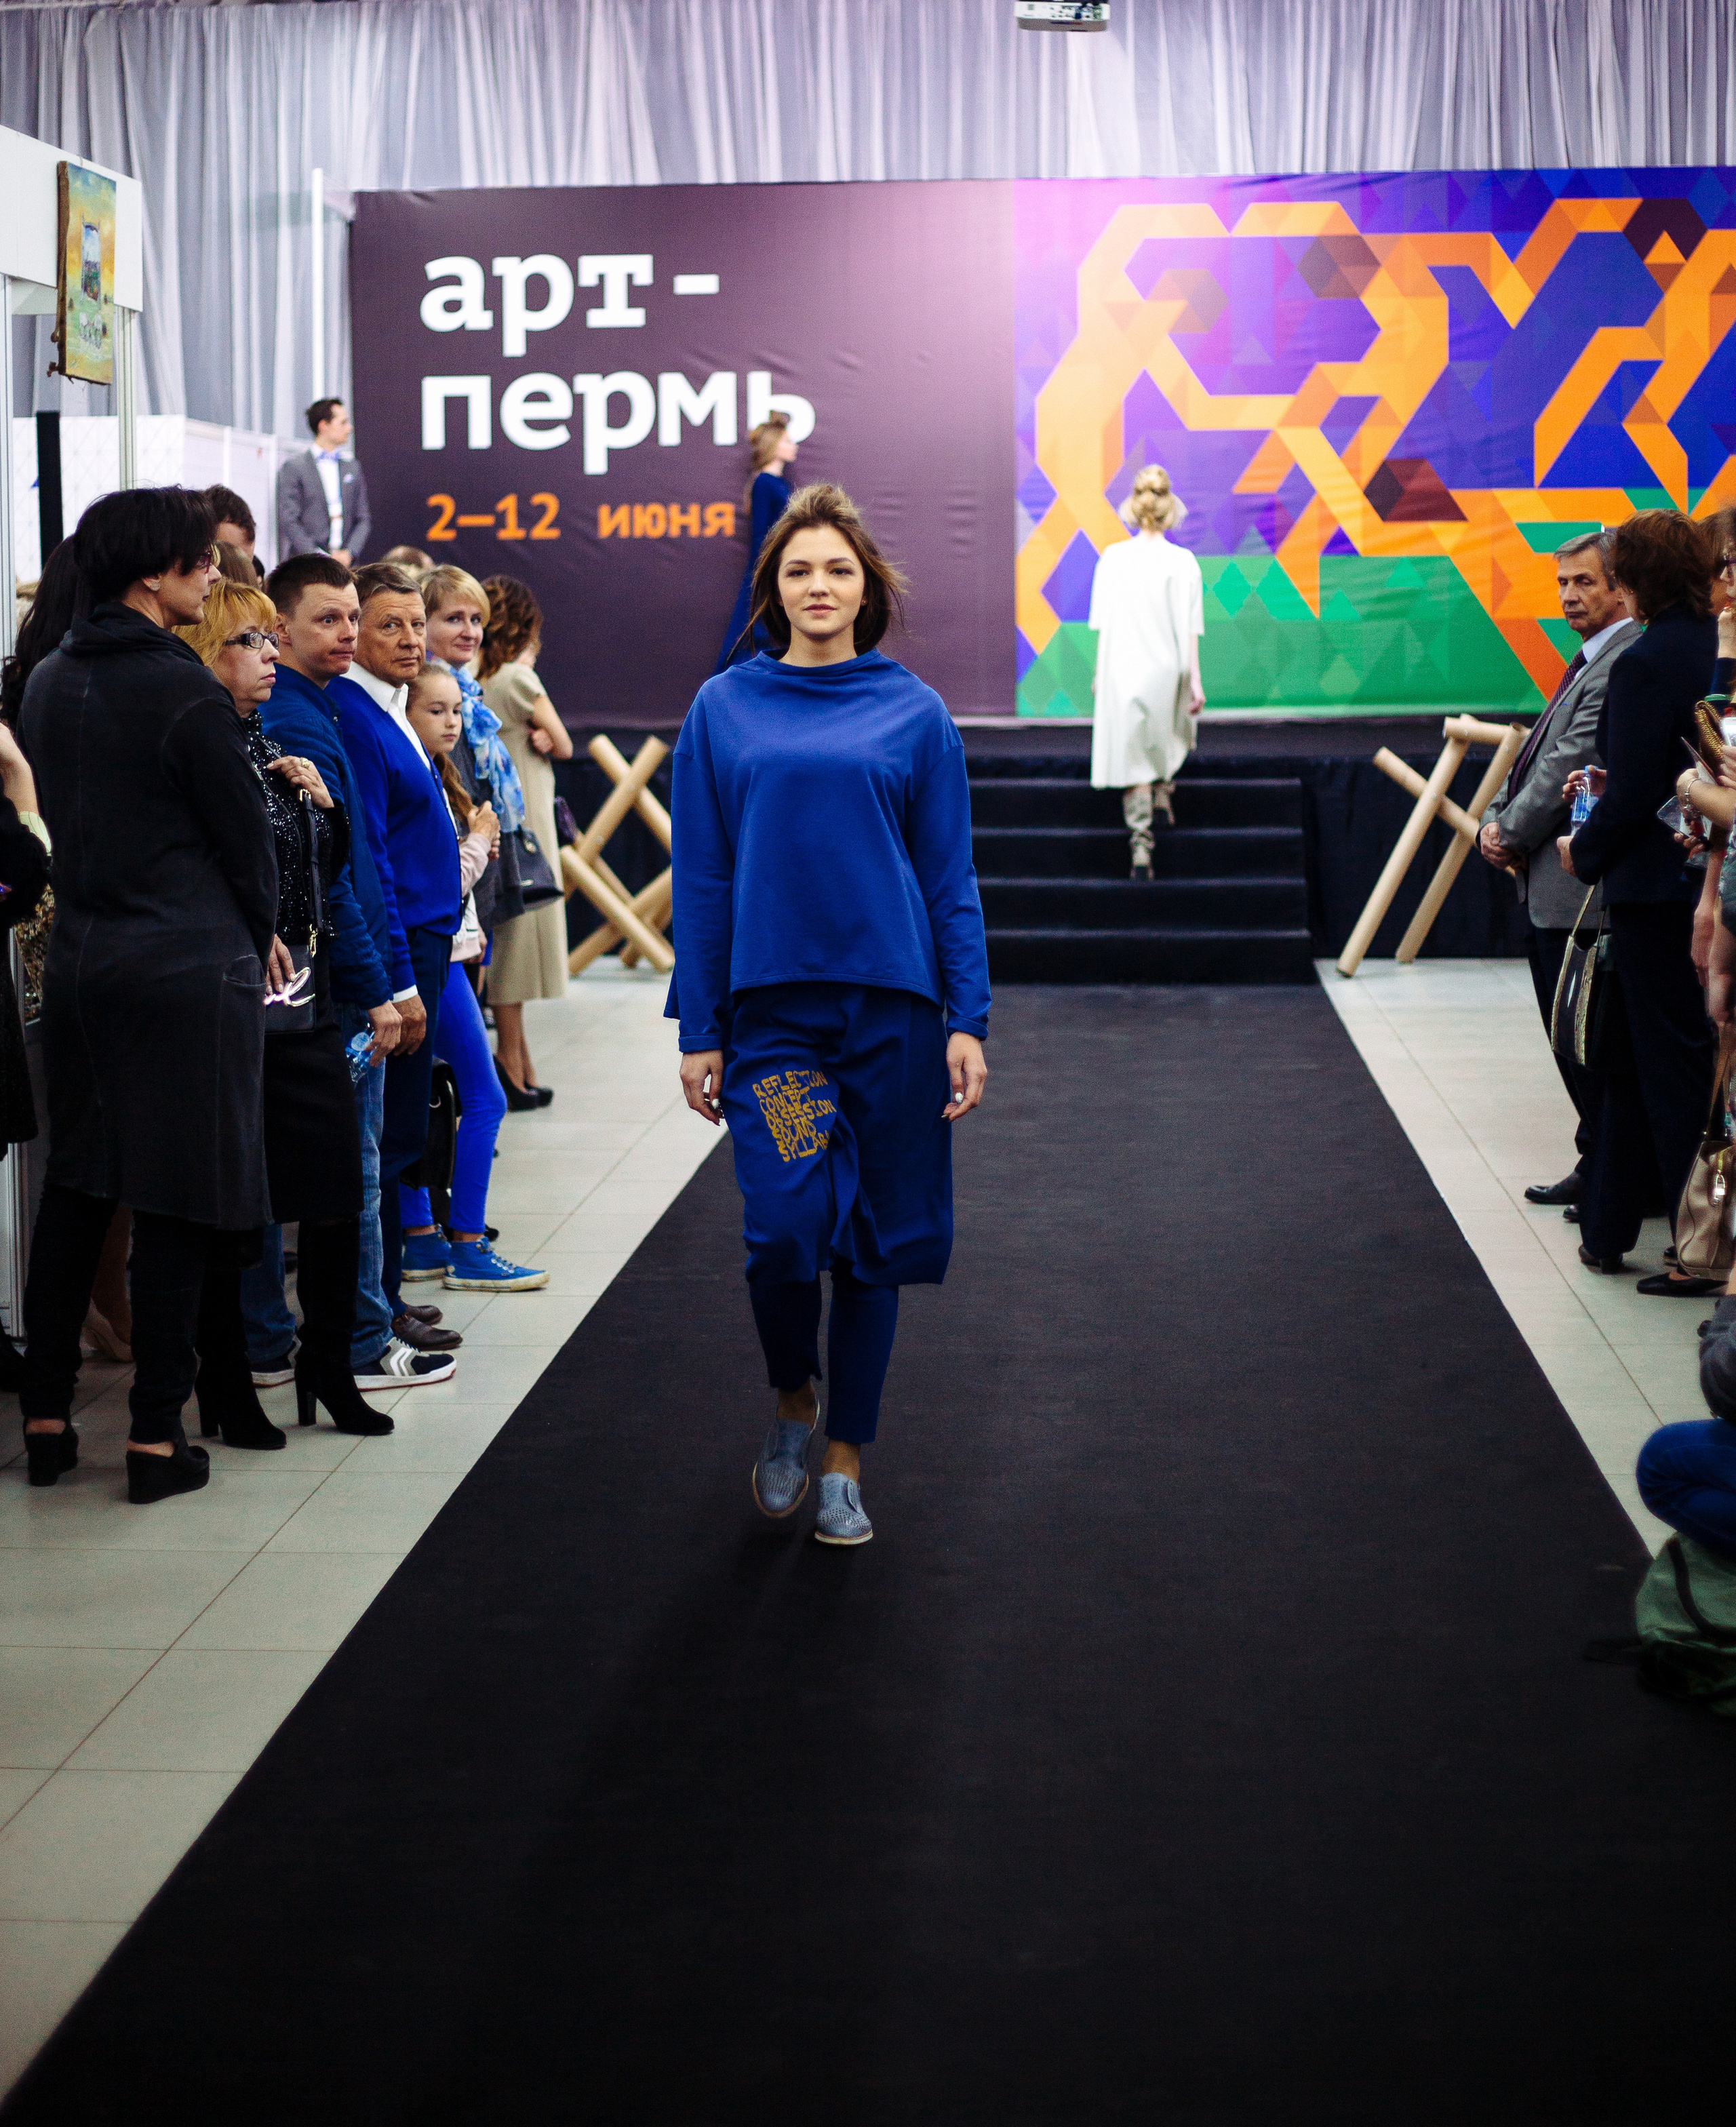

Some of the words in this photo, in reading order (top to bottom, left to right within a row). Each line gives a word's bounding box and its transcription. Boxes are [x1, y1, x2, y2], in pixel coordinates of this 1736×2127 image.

[420, 370, 816, 476] пермь
[597, 502, 736, 539] июня
[752, 1070, 828, 1097] REFLECTION
[759, 1086, 811, 1116] CONCEPT
[766, 1099, 837, 1130] OBSESSION
[772, 1116, 816, 1145] SOUND
